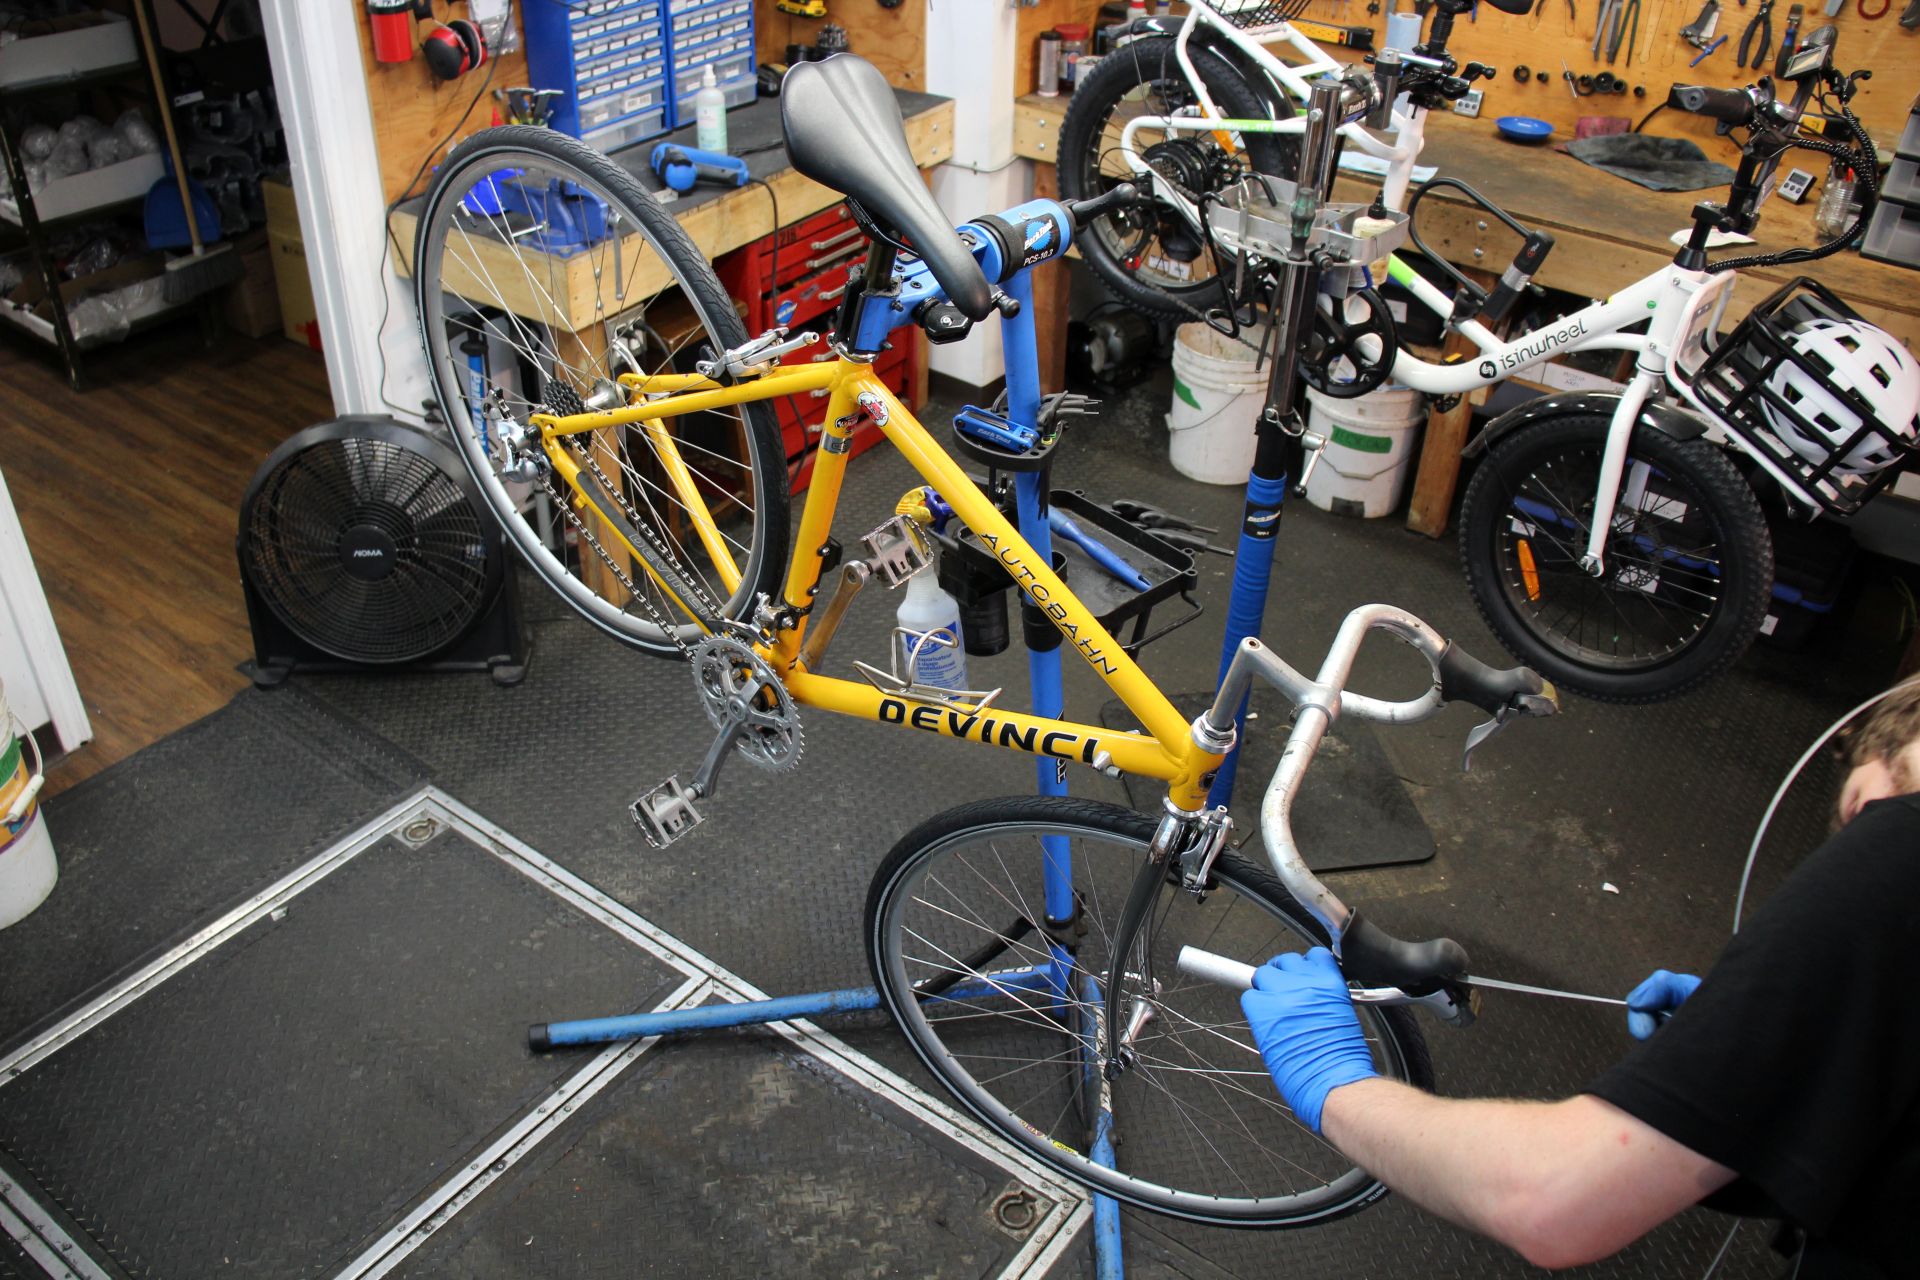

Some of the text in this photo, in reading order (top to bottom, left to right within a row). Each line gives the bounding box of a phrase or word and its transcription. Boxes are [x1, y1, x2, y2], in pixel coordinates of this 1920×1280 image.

[1499, 318, 1588, 370] isinwheel
[353, 549, 384, 558] NOMA
[628, 532, 710, 616] DEVINCI
[981, 532, 1118, 676] AUTOBAHN
[878, 698, 1099, 764] DEVINCI
